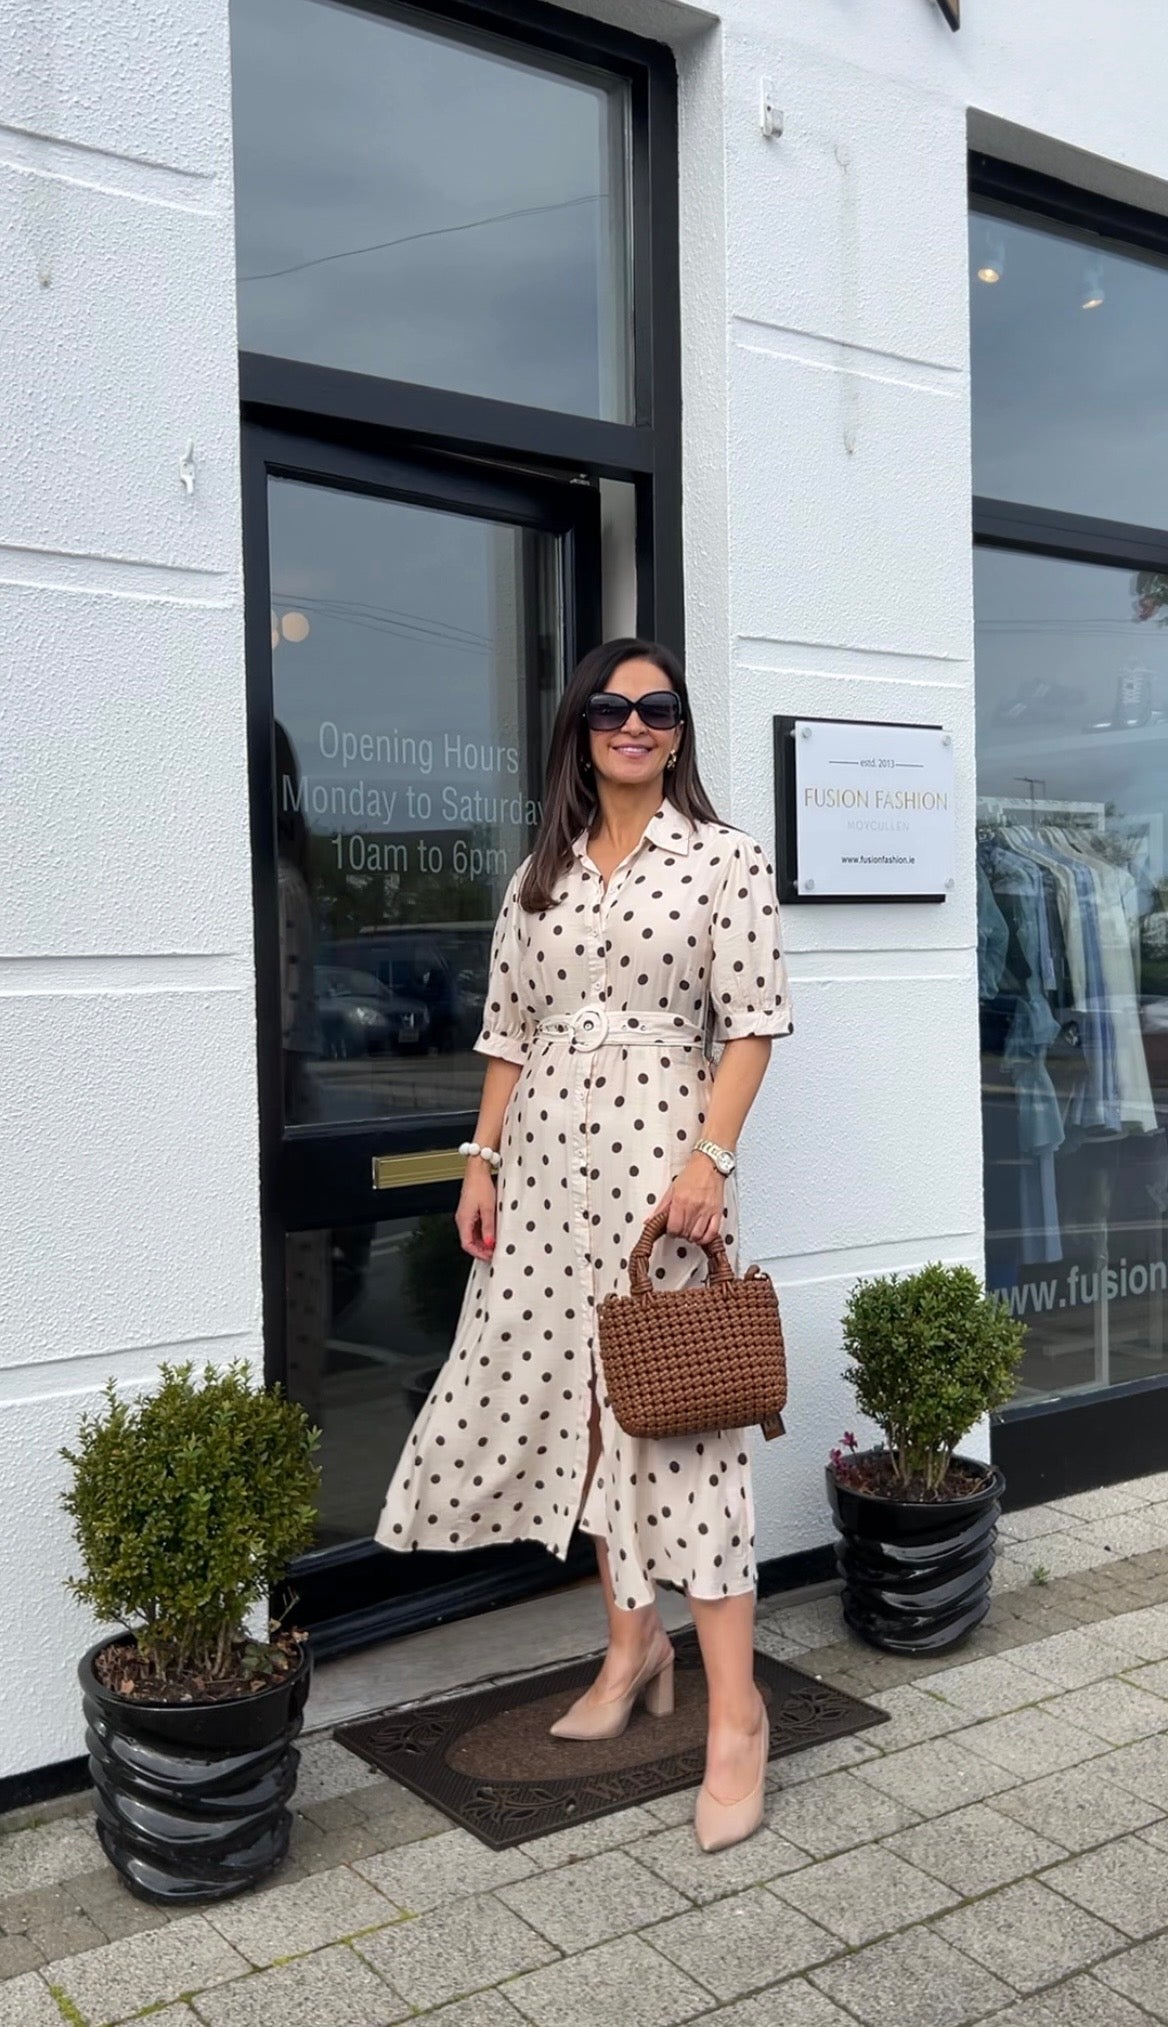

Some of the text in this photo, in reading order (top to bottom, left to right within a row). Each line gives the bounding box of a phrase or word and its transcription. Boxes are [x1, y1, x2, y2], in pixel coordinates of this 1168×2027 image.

[319, 721, 519, 774] Opening Hours
[878, 759, 895, 768] 2013
[282, 774, 397, 825] Monday
[406, 785, 431, 820] to
[804, 787, 948, 811] FUSION FASHION
[332, 833, 508, 881] 10am to 6pm
[841, 855, 915, 865] www.fusionfashion.ie
[986, 1258, 1168, 1318] ww.fusion
